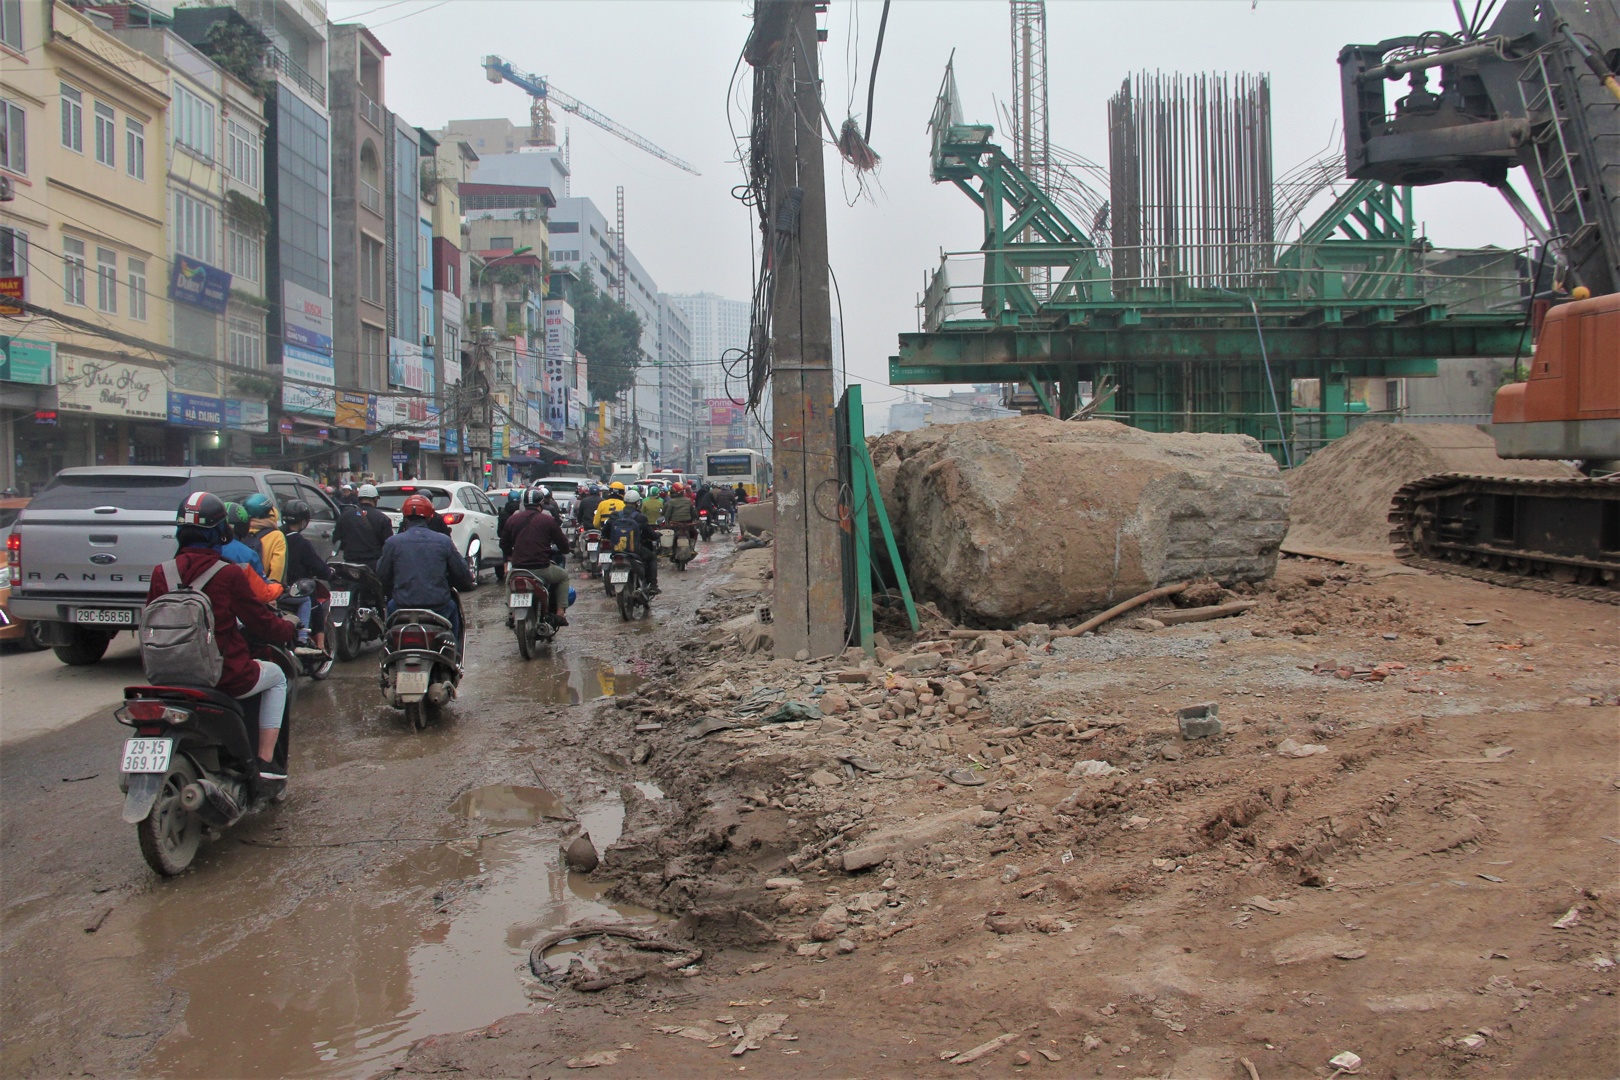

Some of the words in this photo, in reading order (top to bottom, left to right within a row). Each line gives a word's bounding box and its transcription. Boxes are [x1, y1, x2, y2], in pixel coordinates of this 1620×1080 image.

[304, 301, 322, 317] BOSCH
[185, 406, 196, 421] HÀ
[198, 411, 220, 423] DUNG
[28, 572, 151, 582] RANGE
[78, 610, 131, 623] 29C-658.56
[131, 740, 165, 755] 29-X5
[124, 755, 167, 770] 369.17
